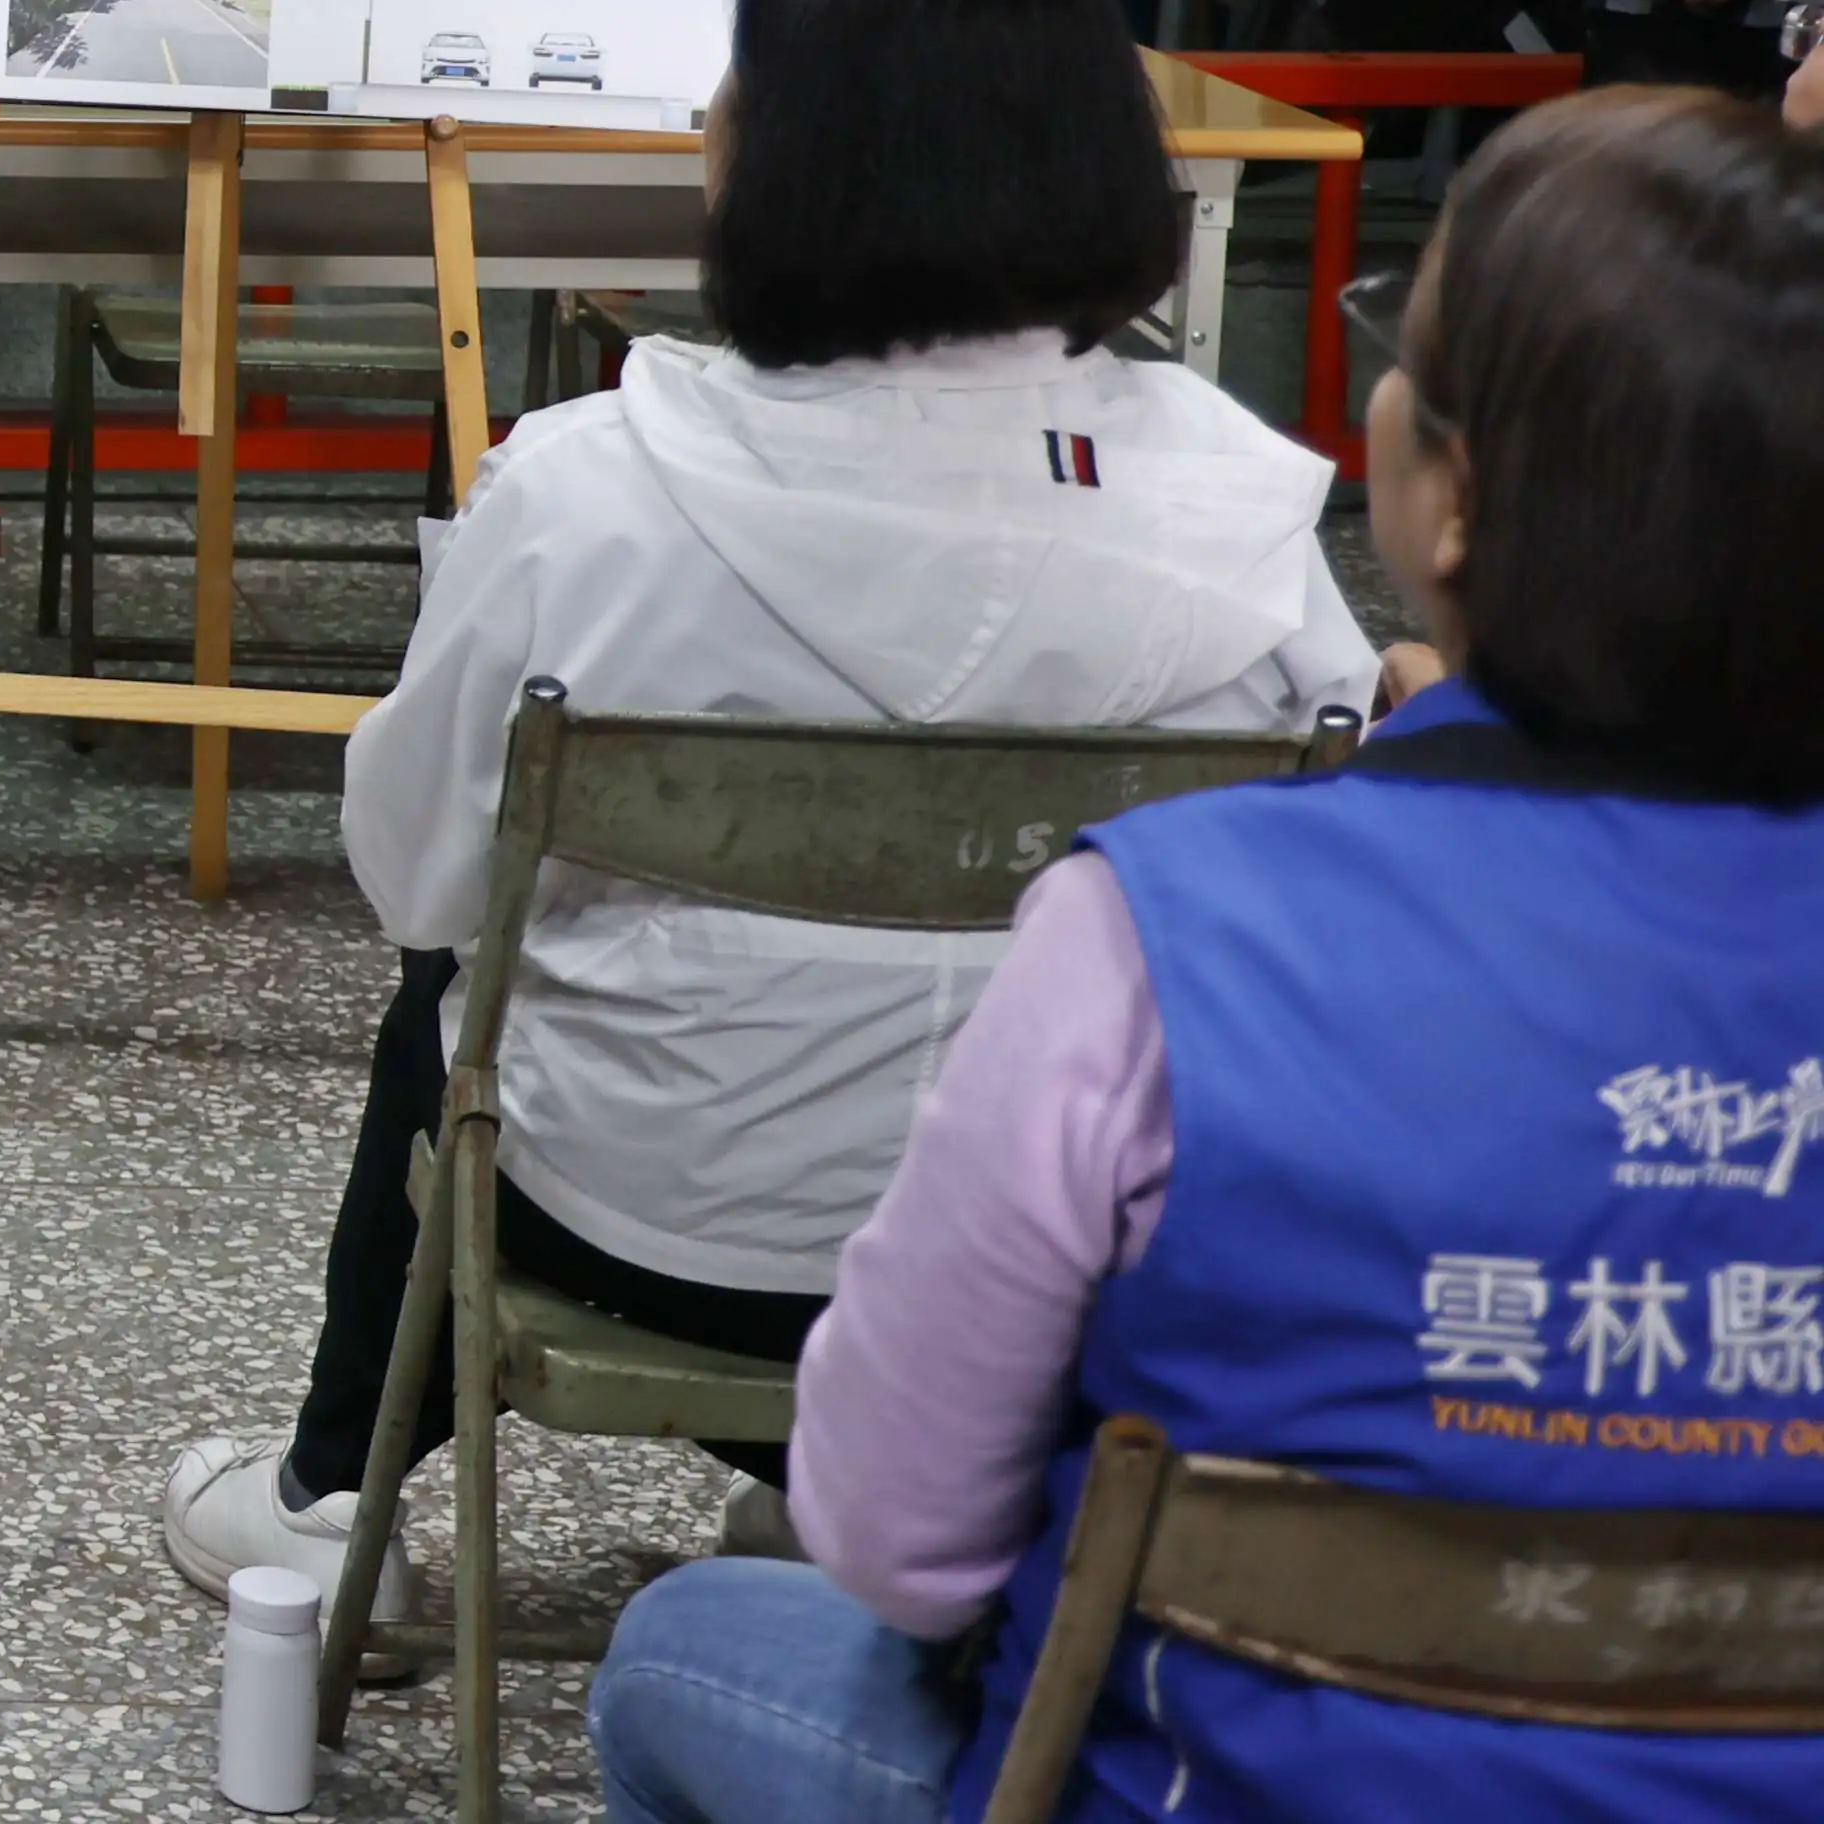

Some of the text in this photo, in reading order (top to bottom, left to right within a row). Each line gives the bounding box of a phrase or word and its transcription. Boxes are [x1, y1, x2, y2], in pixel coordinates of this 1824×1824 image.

[1416, 1251, 1824, 1398] 雲林縣
[1432, 1395, 1589, 1447] YUNLIN
[1598, 1413, 1771, 1458] COUNTY
